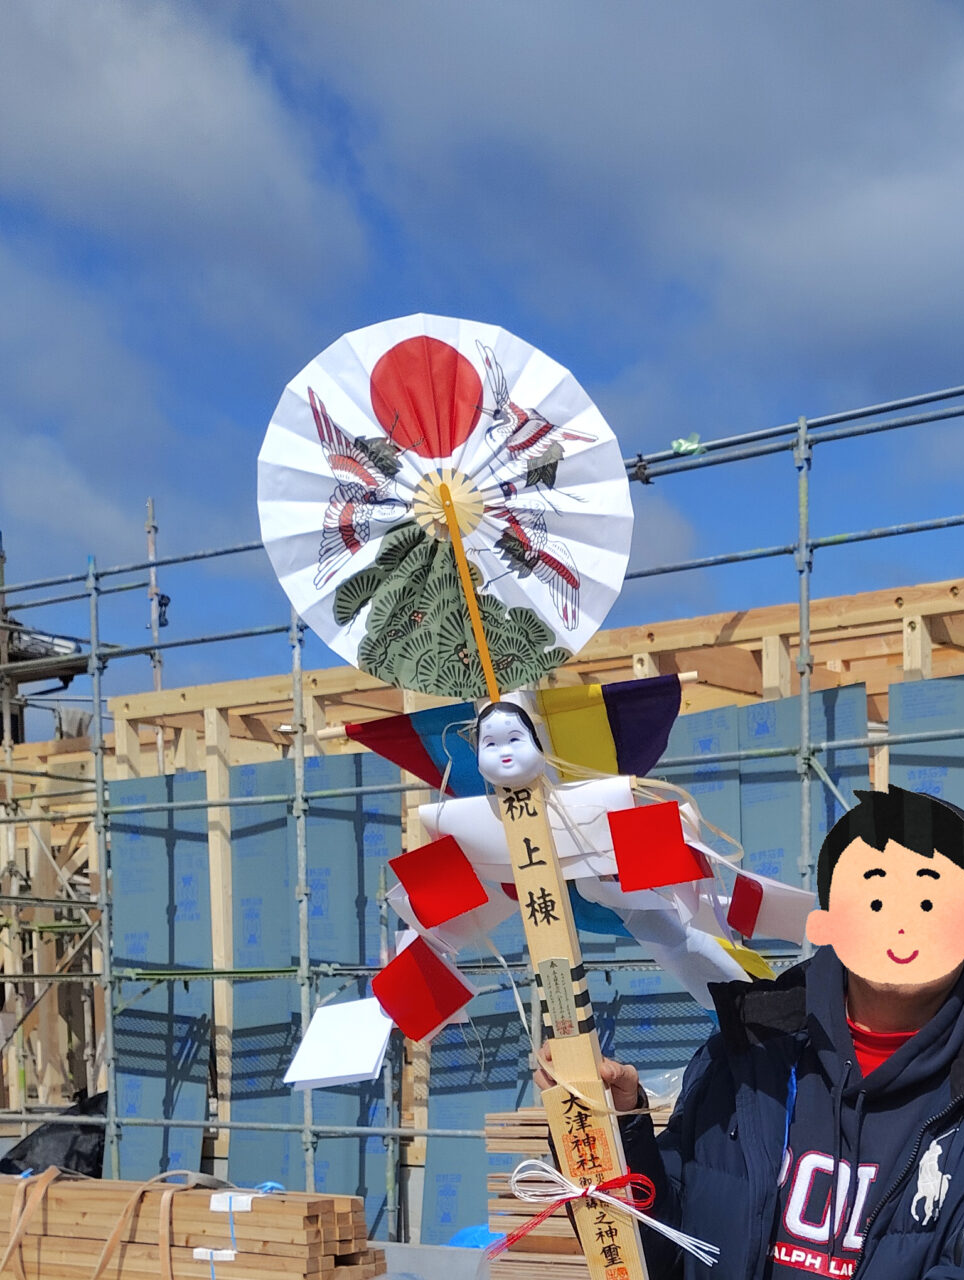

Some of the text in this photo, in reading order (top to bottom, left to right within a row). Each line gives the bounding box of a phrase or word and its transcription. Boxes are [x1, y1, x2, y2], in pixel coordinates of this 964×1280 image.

[502, 786, 561, 928] 祝上棟
[770, 1245, 822, 1269] ALPH
